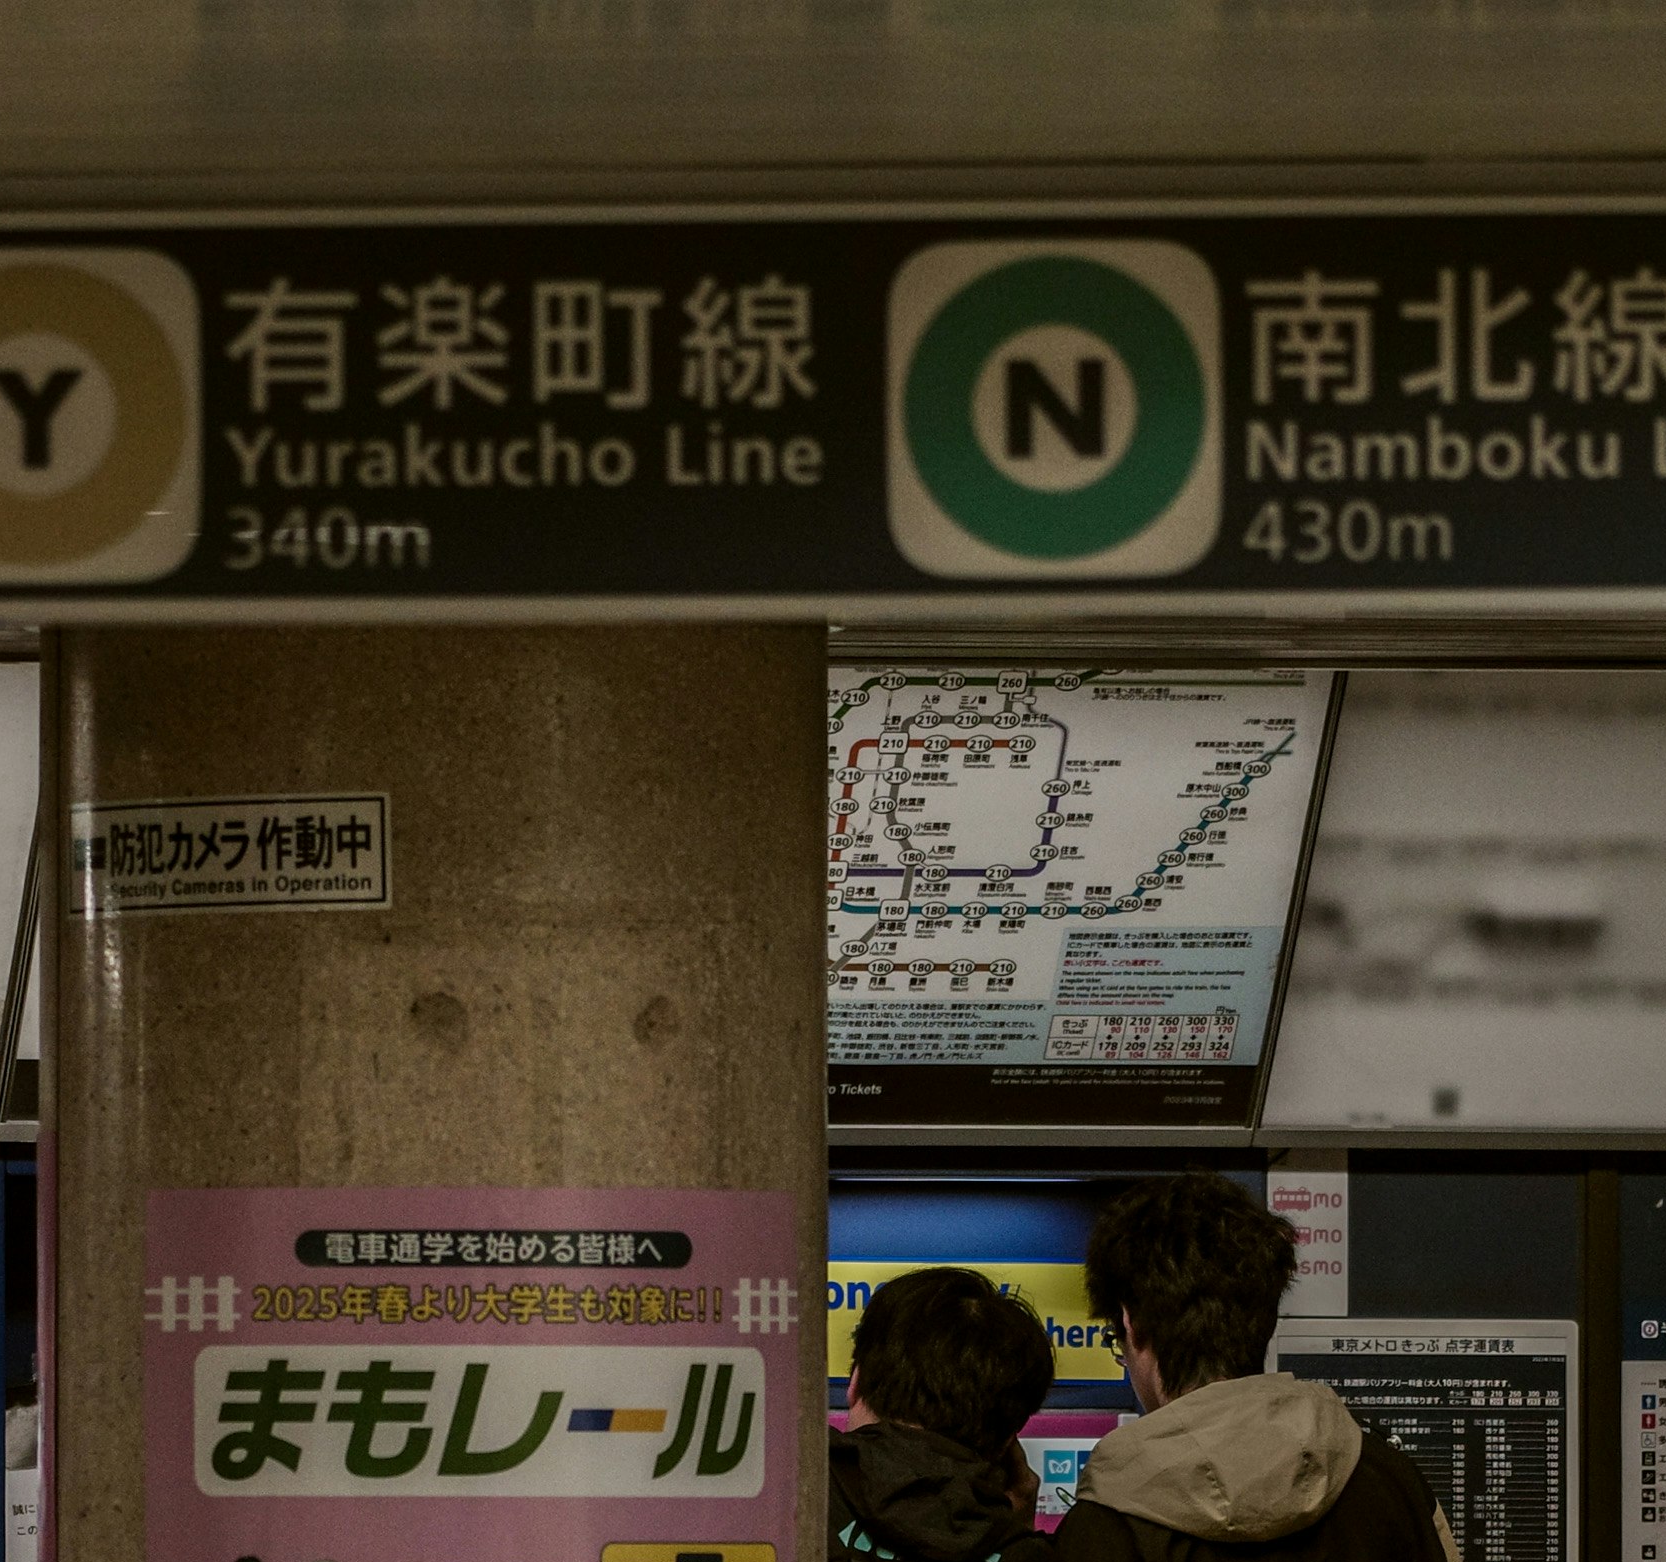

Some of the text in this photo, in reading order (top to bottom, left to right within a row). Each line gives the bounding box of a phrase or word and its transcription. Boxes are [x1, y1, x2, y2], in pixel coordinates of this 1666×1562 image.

[225, 275, 819, 412] 有楽町線
[225, 426, 824, 488] Yurakucho Line
[1243, 416, 1623, 482] Namboku
[225, 503, 432, 573] 340m
[1241, 497, 1455, 563] 430m
[1001, 678, 1022, 688] 260
[882, 738, 904, 748] 210
[1247, 764, 1267, 774] 300
[110, 815, 372, 876] 防犯カメラ作動中
[173, 879, 245, 896] Cameras
[252, 877, 268, 892] in
[274, 875, 372, 893] Operation
[1103, 1016, 1123, 1026] 180
[1130, 1016, 1151, 1026] 210
[1158, 1016, 1179, 1026] 260
[1185, 1016, 1207, 1026] 300
[1213, 1016, 1235, 1026] 330
[840, 1083, 882, 1096] Tickets
[325, 1234, 662, 1266] 電車通学を始める皆様へ
[1332, 1339, 1397, 1354] 東京メトロ
[212, 1360, 757, 1480] まもレール
